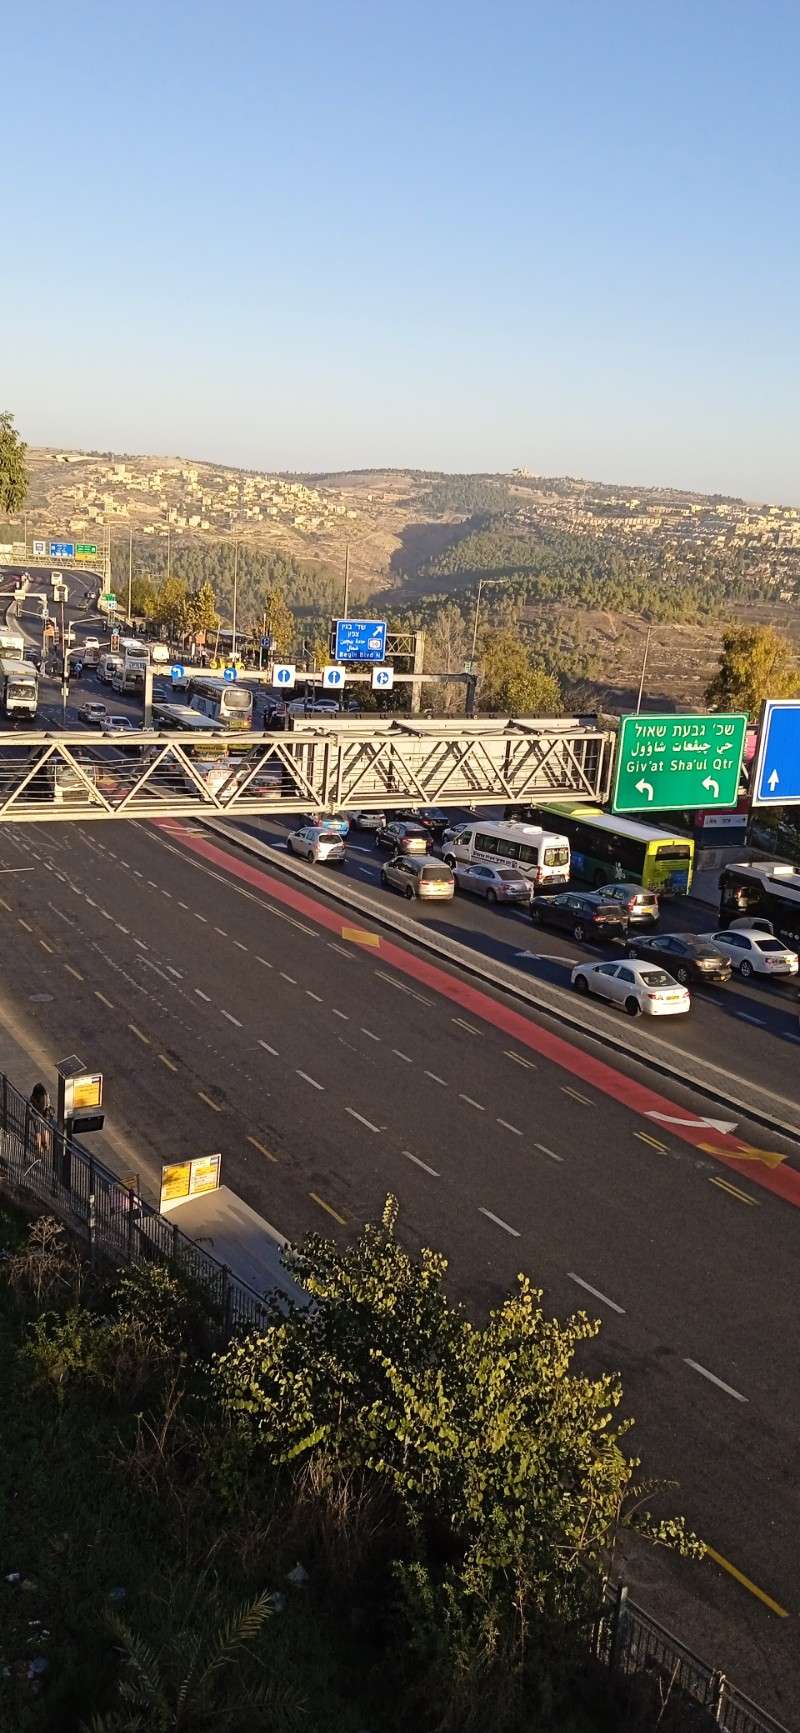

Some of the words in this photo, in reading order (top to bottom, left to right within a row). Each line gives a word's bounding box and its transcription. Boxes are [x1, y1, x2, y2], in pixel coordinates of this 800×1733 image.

[634, 723, 667, 737] שאול
[672, 724, 706, 738] גבעת
[712, 723, 735, 736] שכ'
[716, 741, 733, 754] حي
[626, 760, 664, 773] Giv'at
[670, 758, 707, 771] Sha'ul
[713, 758, 733, 770] Qtr
